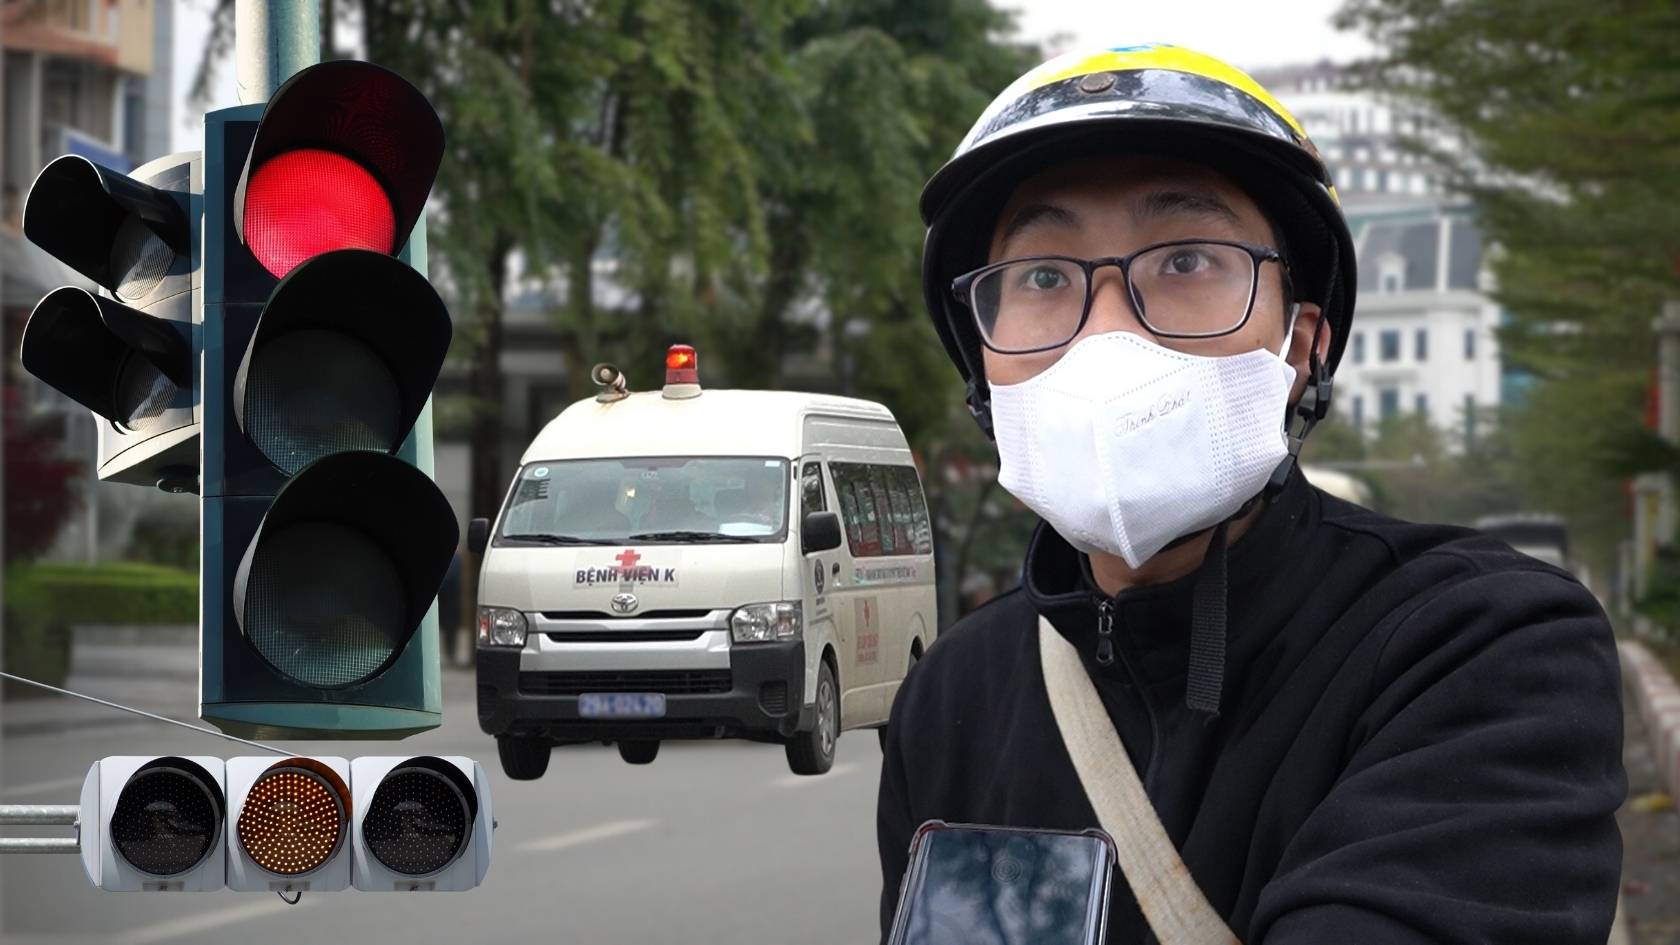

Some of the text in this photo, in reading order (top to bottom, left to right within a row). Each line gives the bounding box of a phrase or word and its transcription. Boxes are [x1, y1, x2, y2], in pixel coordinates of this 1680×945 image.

[576, 565, 676, 586] BỆNH VIỆN K
